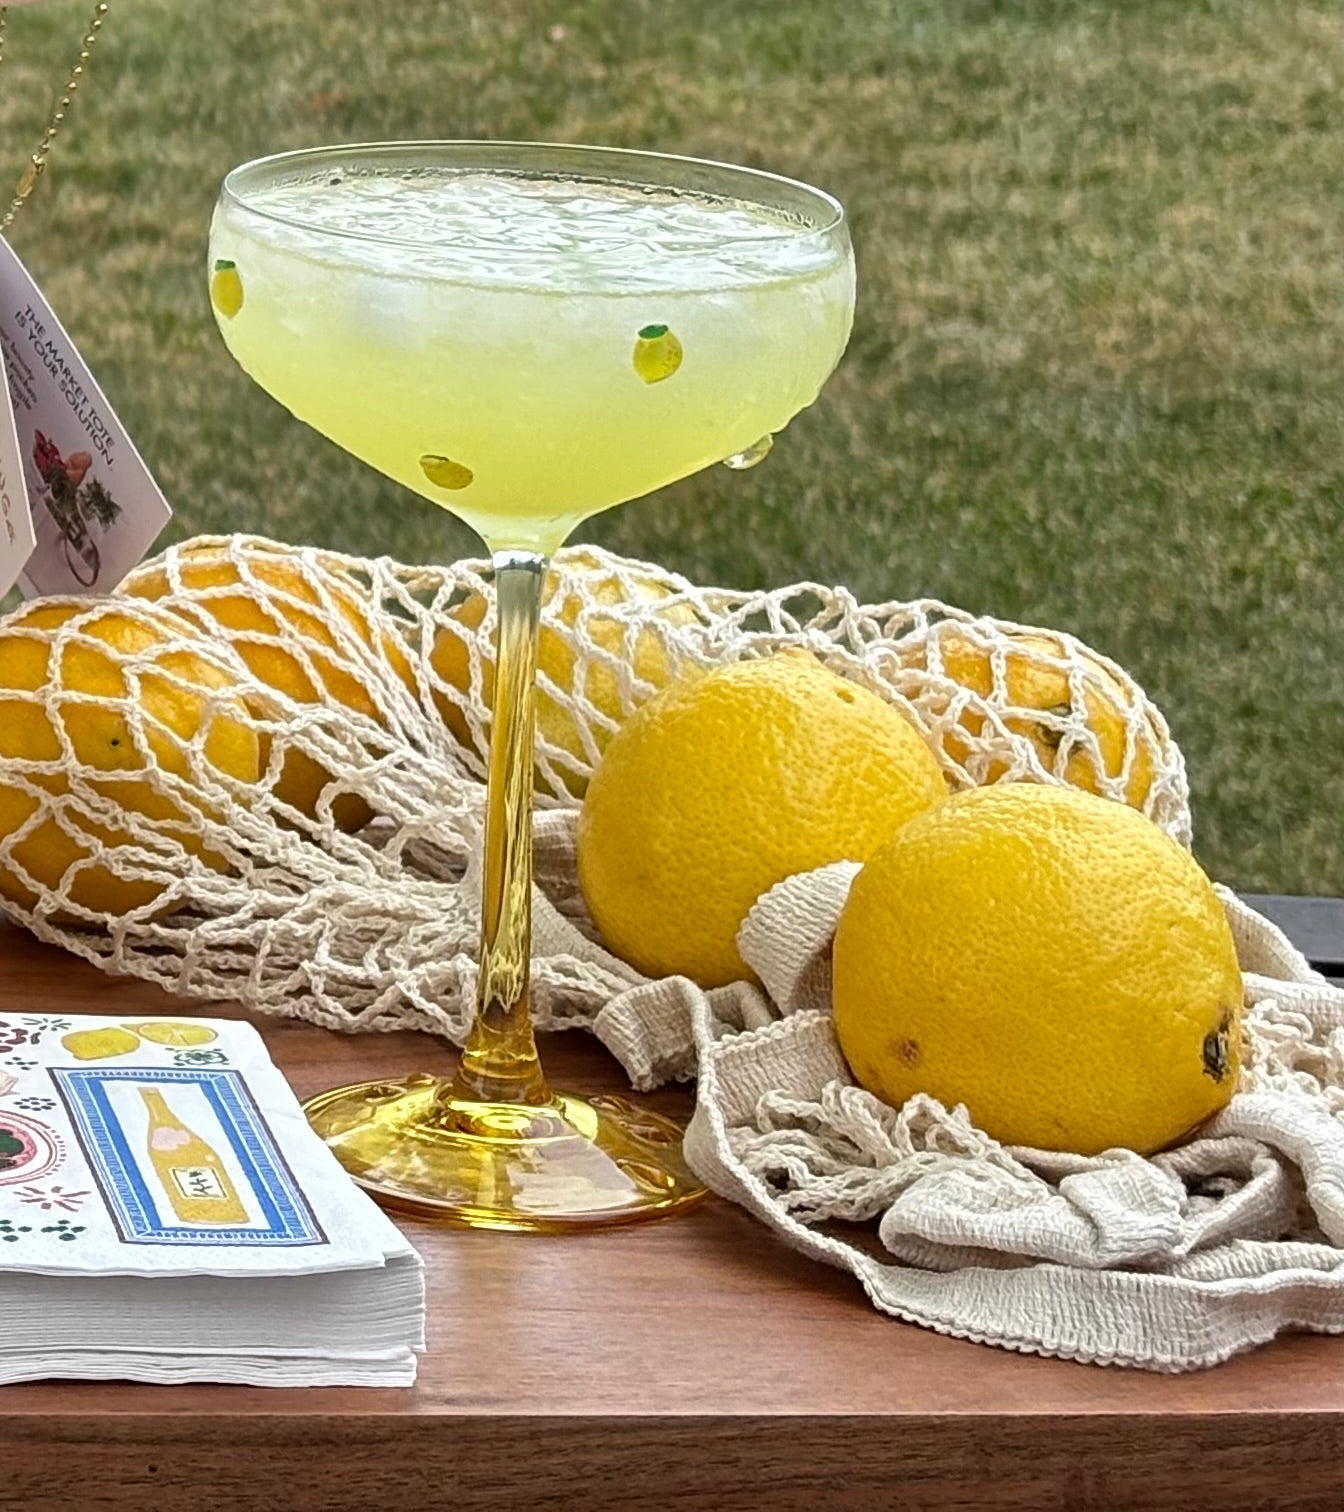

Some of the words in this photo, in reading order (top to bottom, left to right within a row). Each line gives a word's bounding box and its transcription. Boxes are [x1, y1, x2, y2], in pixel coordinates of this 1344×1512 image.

[14, 310, 26, 329] IS
[27, 330, 59, 378] YOUR
[24, 304, 47, 337] THE
[45, 340, 90, 406] MARKET
[88, 406, 115, 449] TOTE
